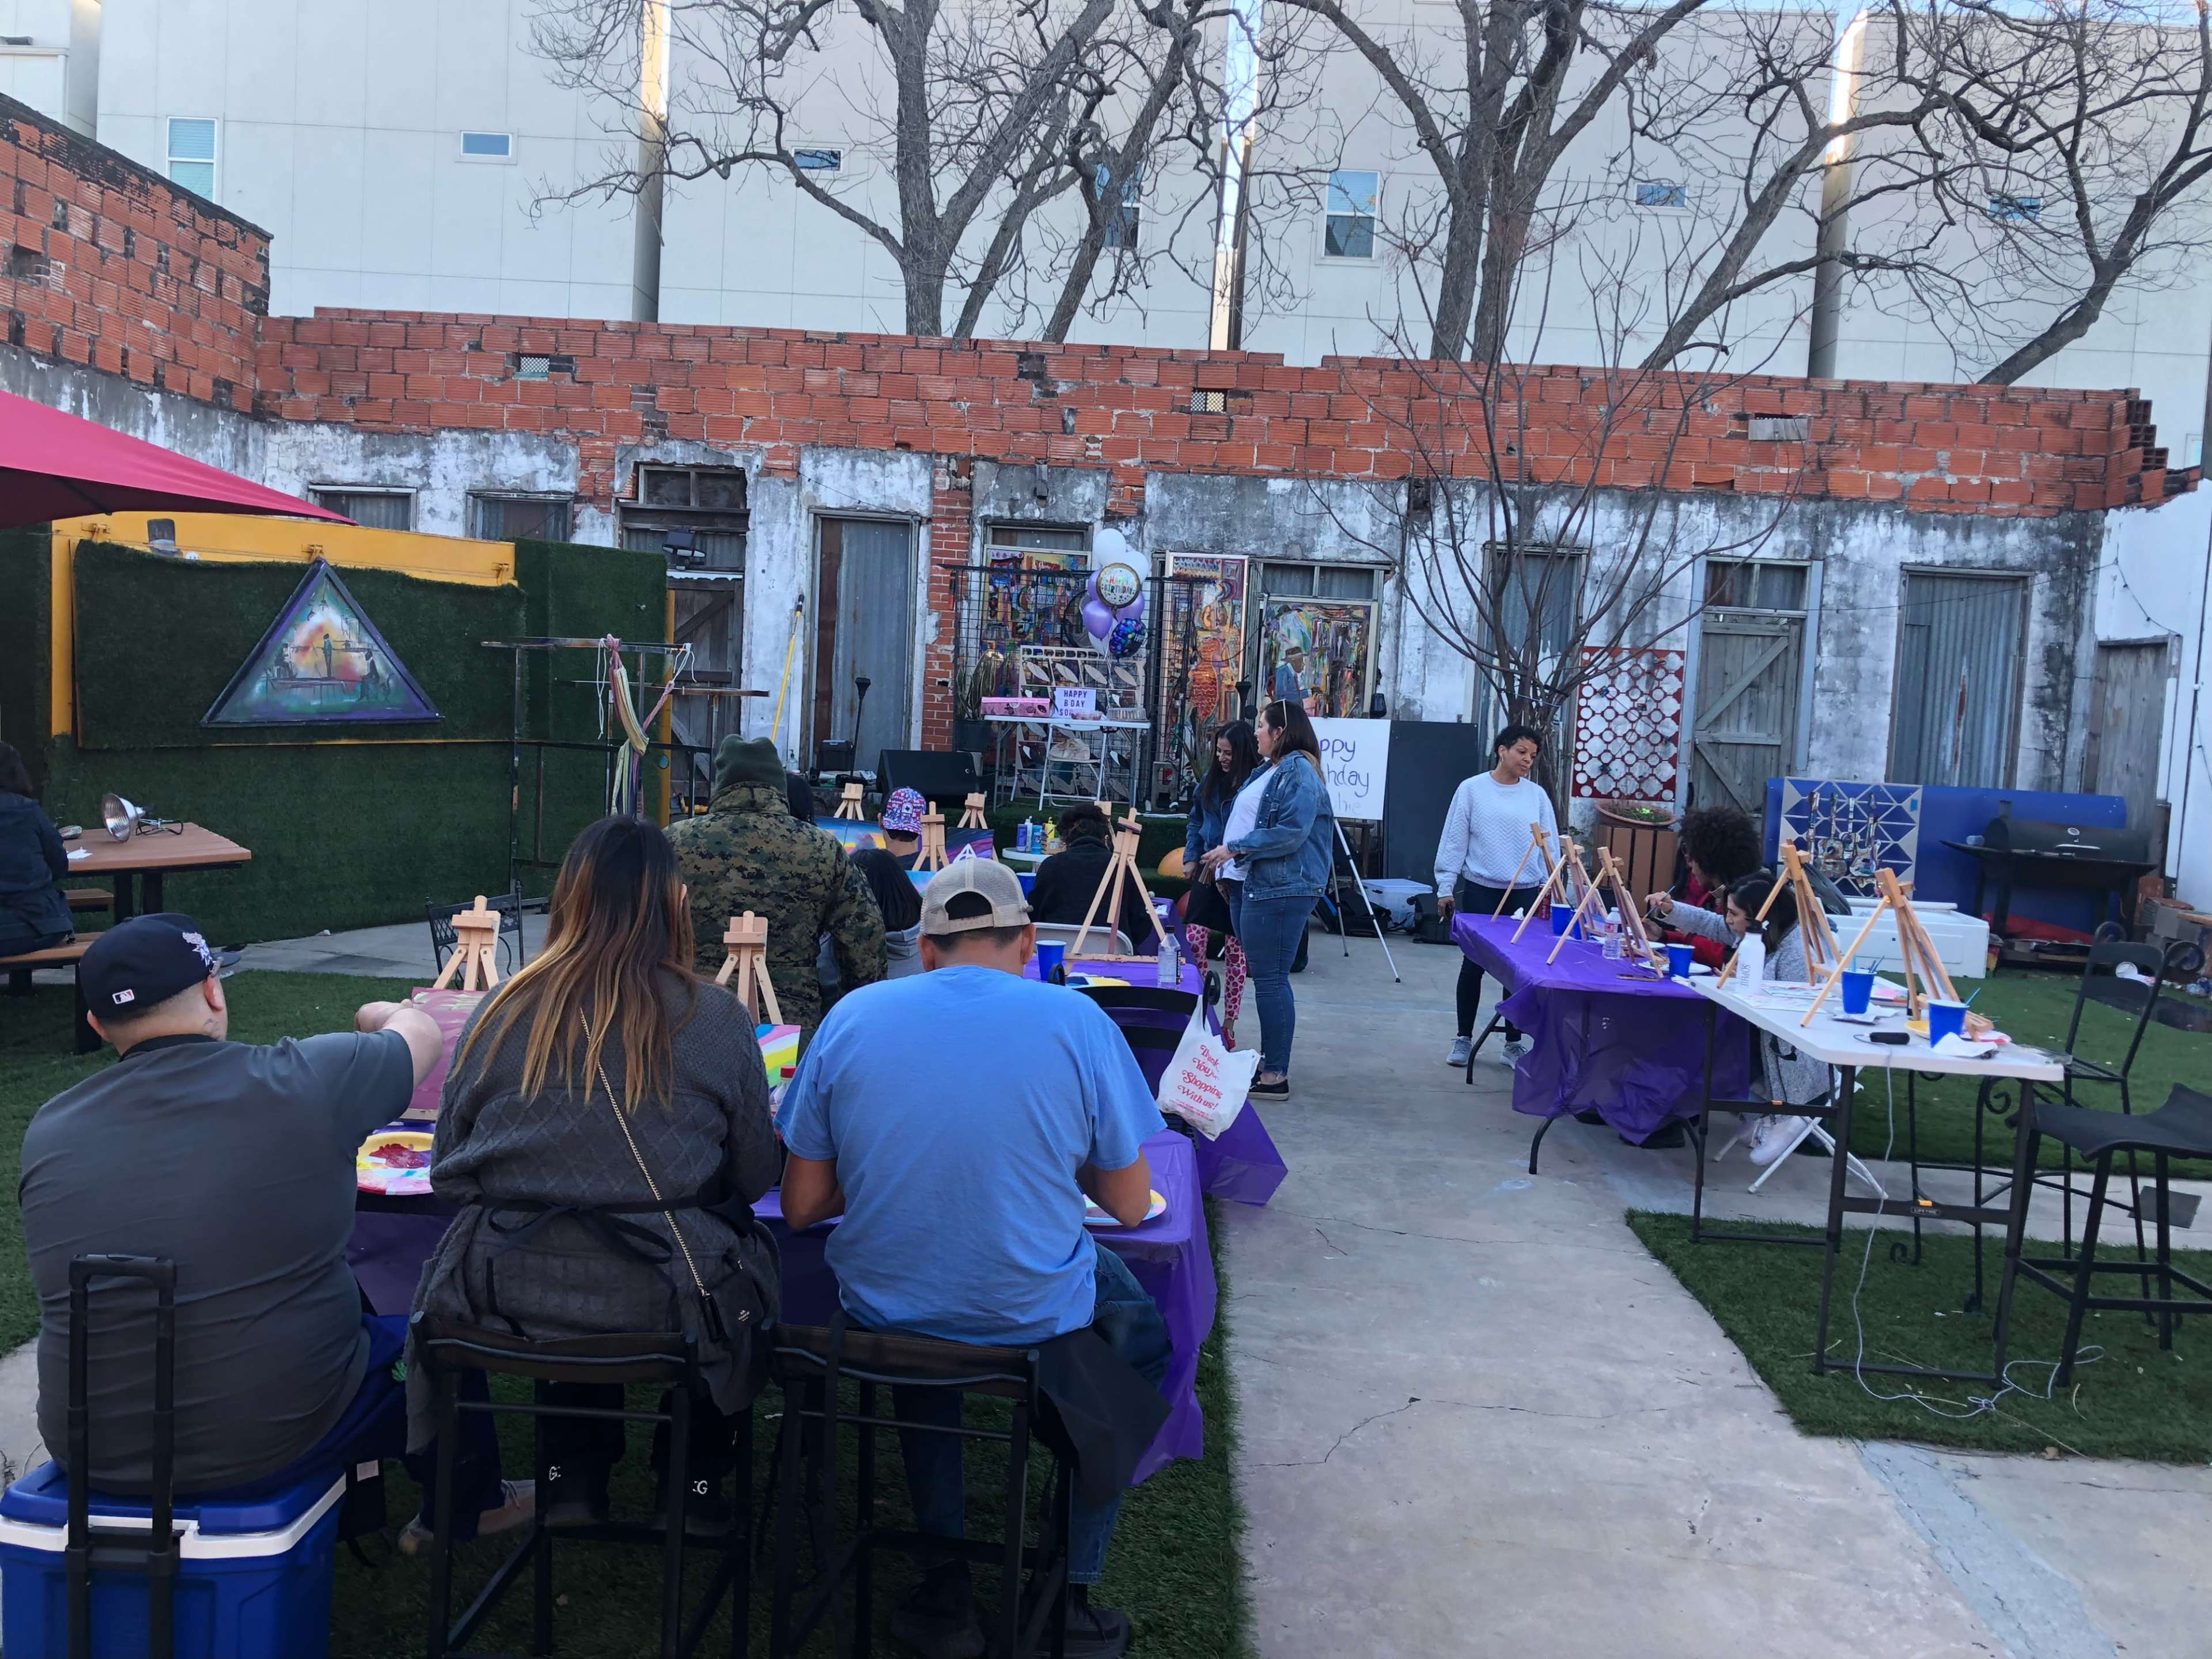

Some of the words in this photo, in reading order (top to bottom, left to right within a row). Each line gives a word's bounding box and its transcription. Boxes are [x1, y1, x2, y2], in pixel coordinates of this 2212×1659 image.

[1064, 690, 1088, 698] HAPPY
[1320, 739, 1355, 762] ppy
[1327, 764, 1369, 798] hday
[1192, 1057, 1210, 1074] You
[1200, 1045, 1219, 1072] Thank
[1182, 1070, 1224, 1099] Shopping
[1177, 1085, 1203, 1104] With
[1203, 1100, 1219, 1109] us!
